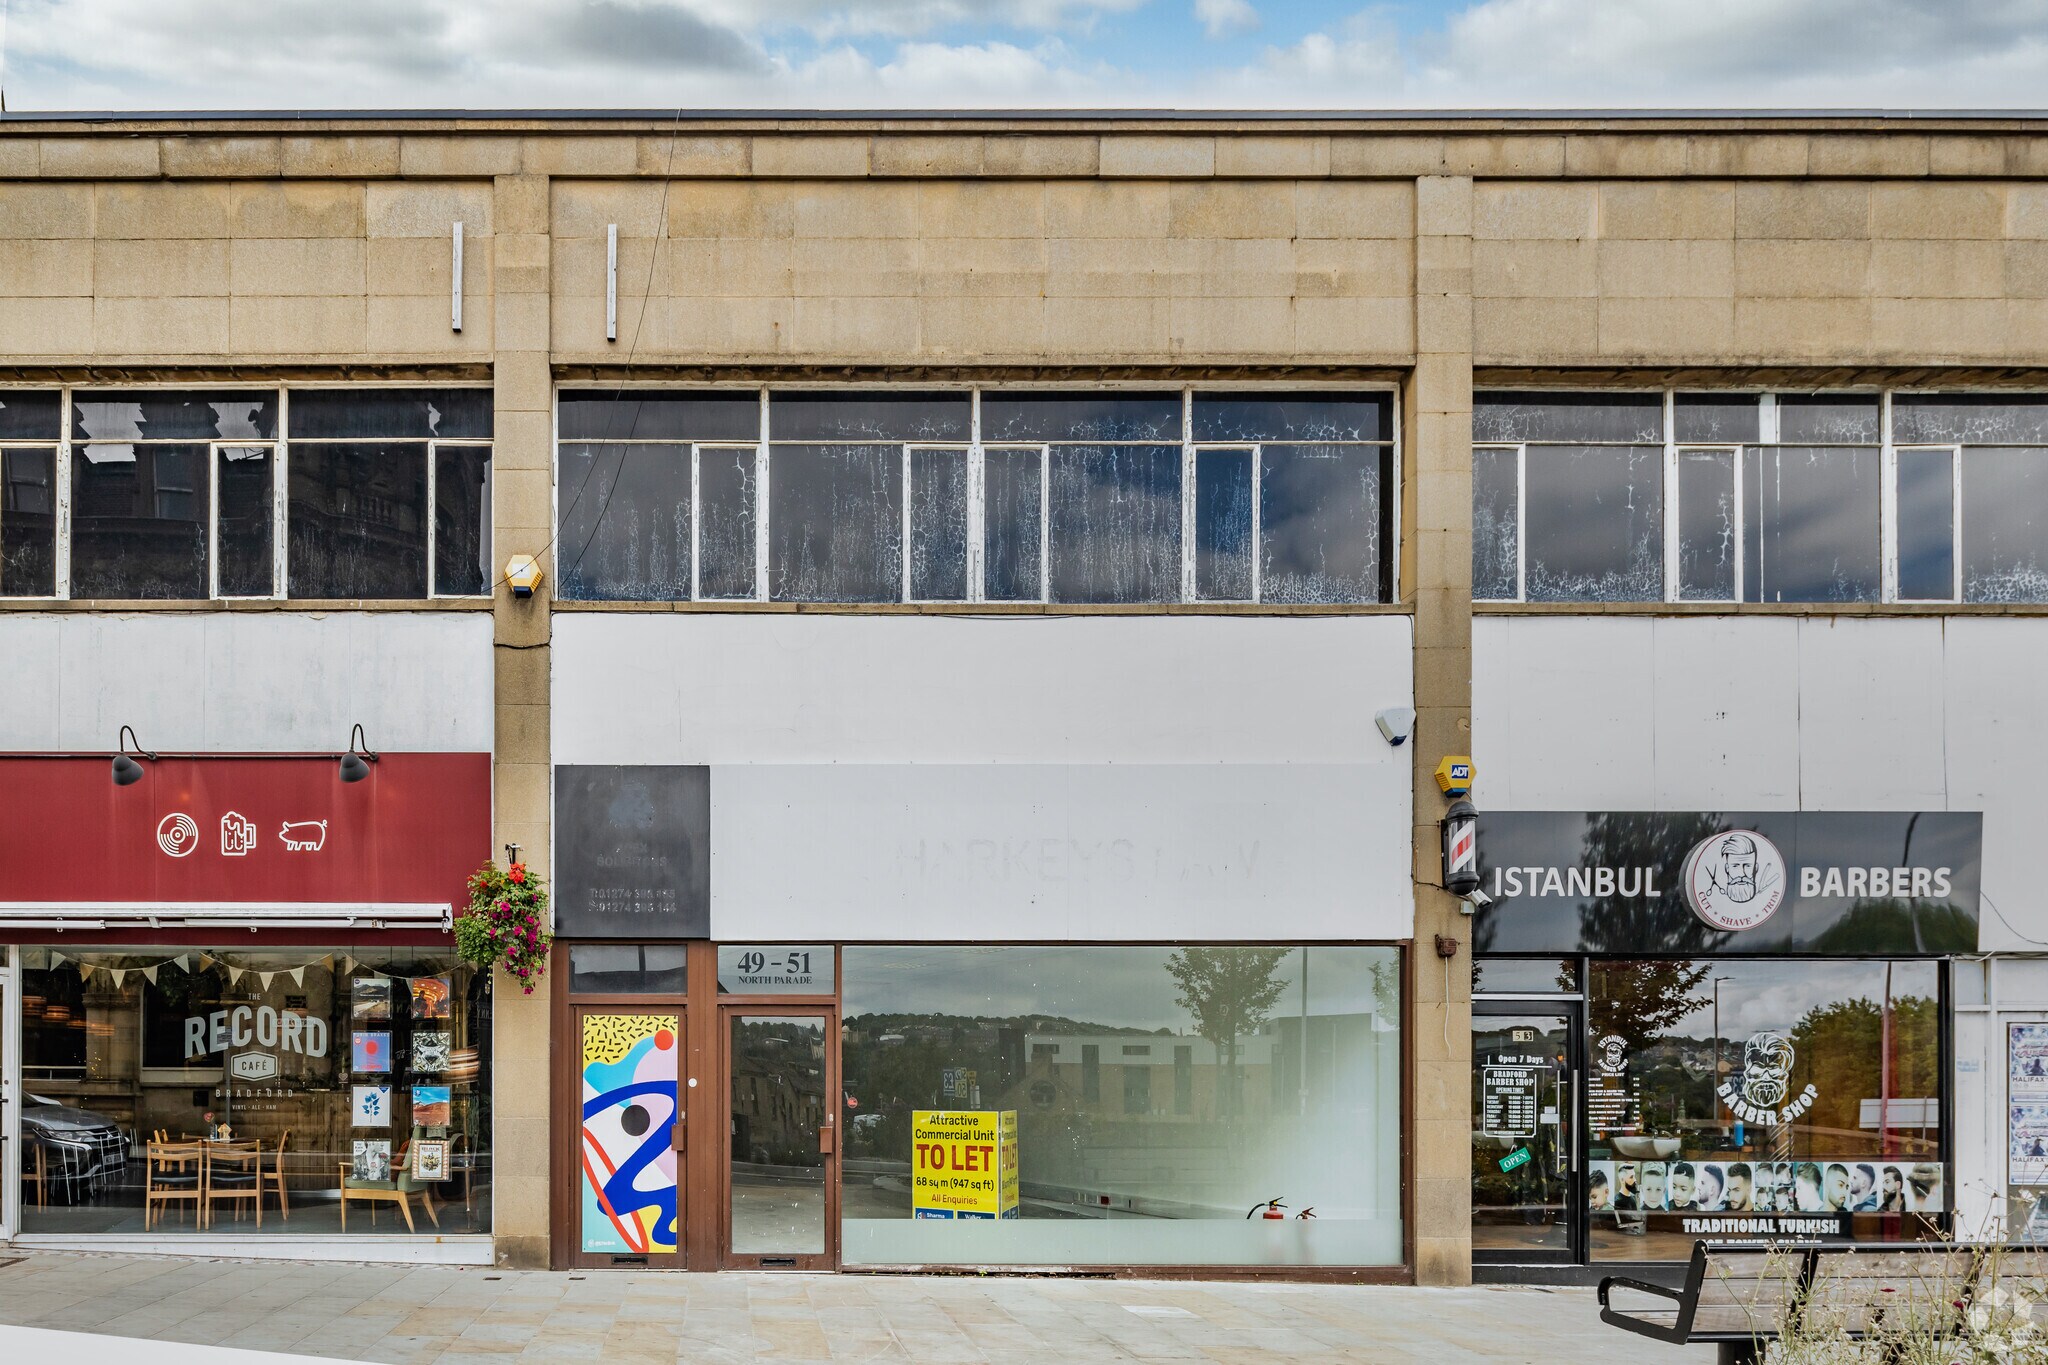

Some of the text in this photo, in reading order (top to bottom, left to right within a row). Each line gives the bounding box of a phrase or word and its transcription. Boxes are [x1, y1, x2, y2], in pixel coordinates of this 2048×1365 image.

[1452, 766, 1468, 777] ADT
[1495, 866, 1661, 898] ISTANBUL
[1800, 866, 1951, 898] BARBERS
[1698, 890, 1780, 927] CUT SHAVE TRIM
[737, 952, 765, 974] 49
[786, 952, 812, 974] 51
[738, 976, 813, 985] NORTH PARADE
[248, 993, 261, 1001] THE
[184, 1005, 328, 1059] RECORD
[1597, 1034, 1628, 1049] ISTANBUL
[241, 1059, 267, 1071] CAFÉ
[1498, 1055, 1544, 1065] Open 7 Days
[1493, 1070, 1528, 1078] BRADFORD
[1486, 1078, 1534, 1086] BARBER SHOP
[215, 1088, 293, 1098] BRADFORD
[1716, 1082, 1778, 1126] BARBER
[1781, 1083, 1819, 1122] SHOP
[929, 1114, 979, 1126] Attractive
[915, 1128, 971, 1141] Commercial
[973, 1130, 995, 1141] Unit
[916, 1144, 994, 1172] TO LET
[1503, 1151, 1527, 1169] OPEN
[940, 1180, 949, 1188] m
[950, 1178, 969, 1189] (947
[971, 1181, 981, 1191] sq
[983, 1179, 995, 1191] ft)
[931, 1194, 978, 1206] All Enquiries
[1682, 1218, 1840, 1234] TRADITIONAL TURKISH
